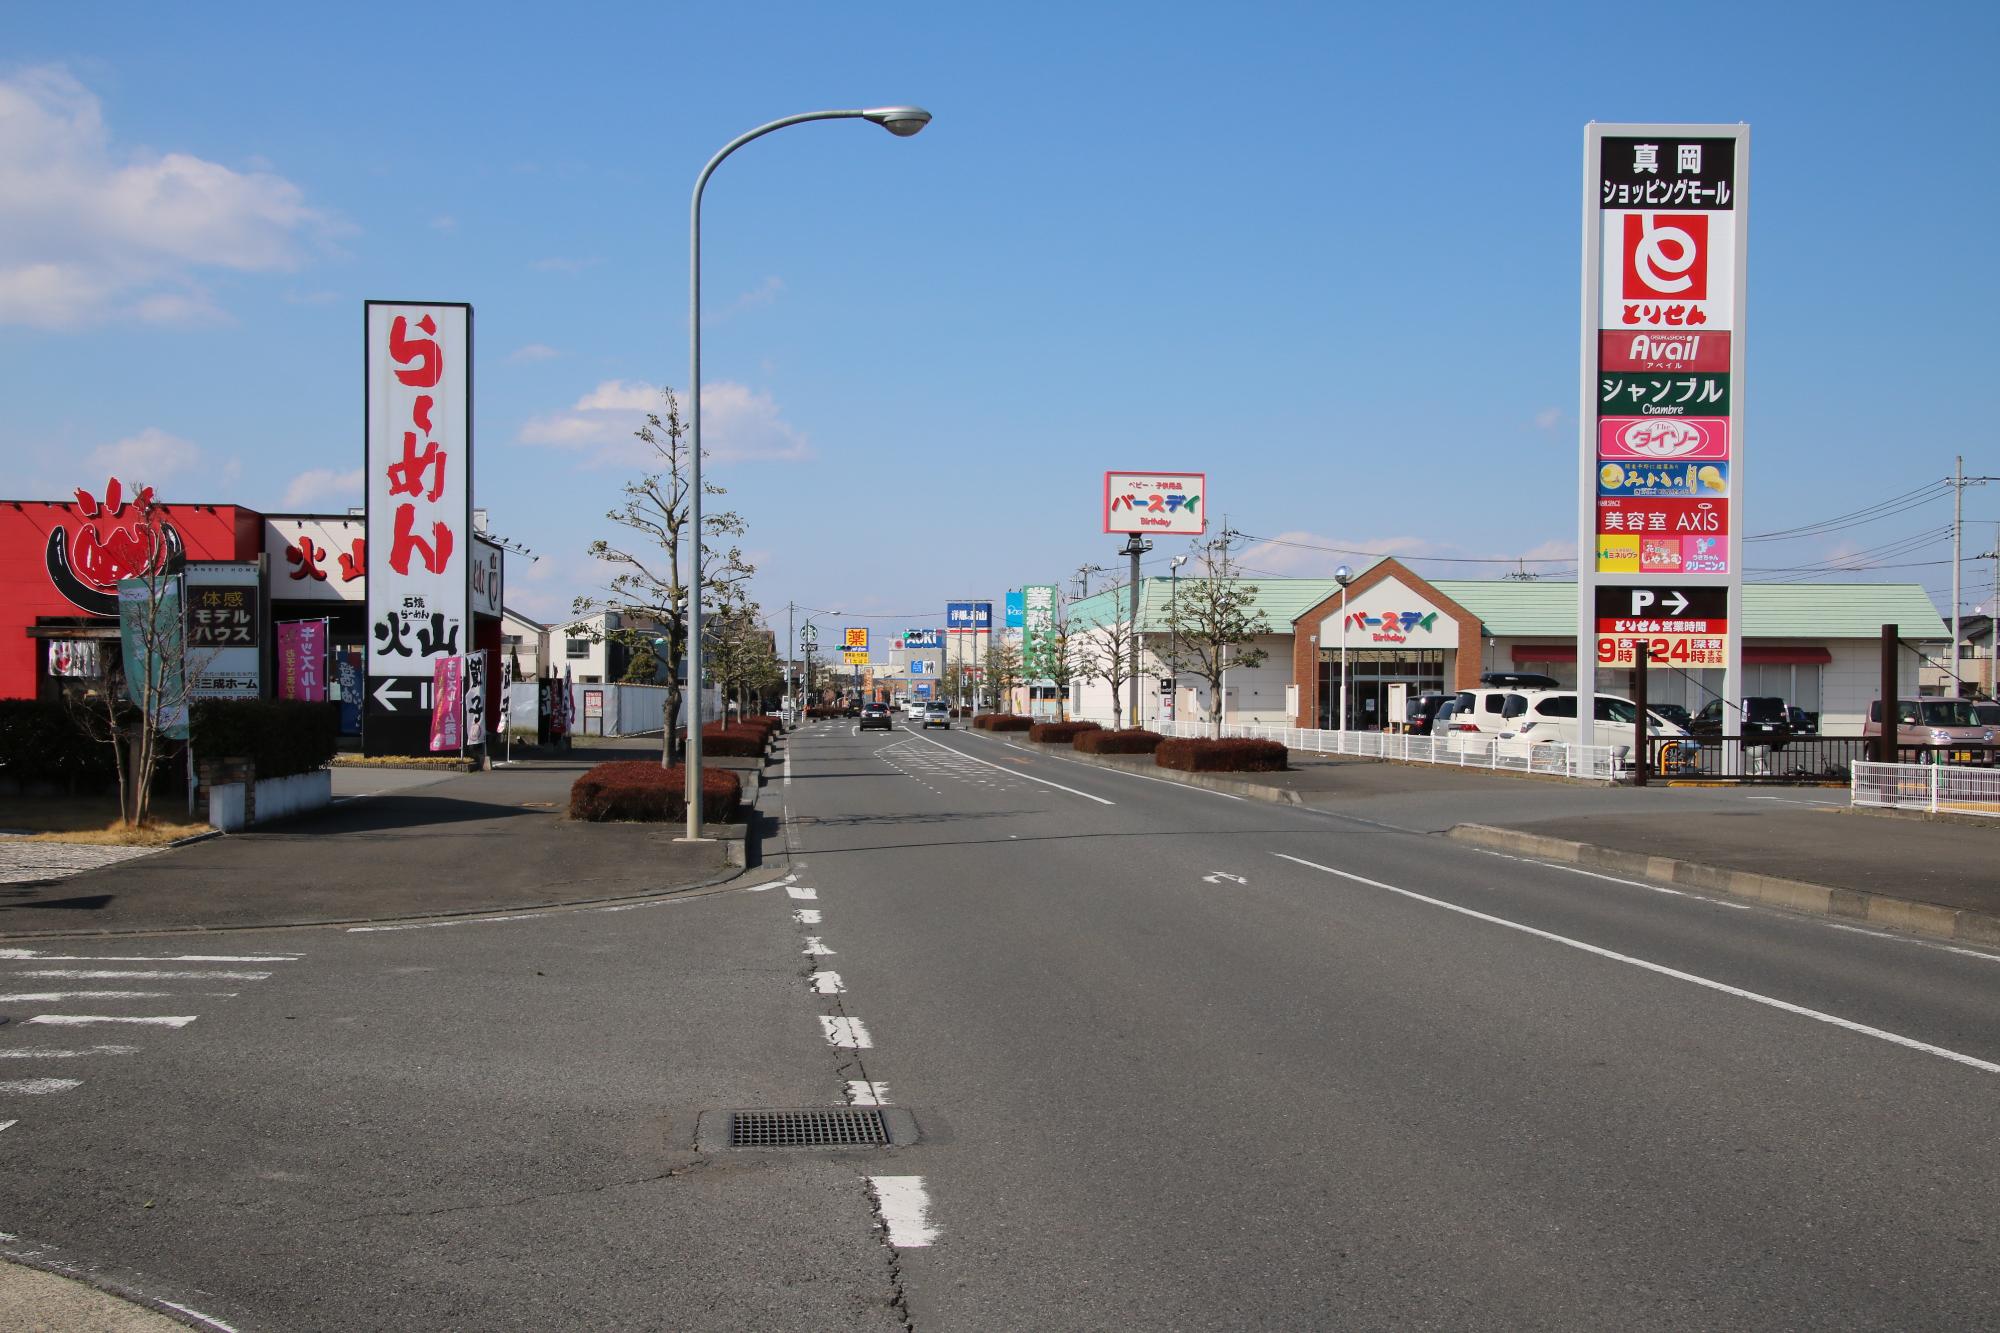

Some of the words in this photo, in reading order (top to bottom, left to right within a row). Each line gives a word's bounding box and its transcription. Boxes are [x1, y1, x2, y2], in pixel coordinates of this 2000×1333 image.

[1633, 144, 1702, 174] 真岡
[1603, 179, 1731, 205] ショッピングモール
[1622, 304, 1707, 326] とりせん
[1628, 334, 1700, 361] Avail
[1603, 377, 1724, 403] シャンブル
[1642, 403, 1684, 415] Chambre
[386, 313, 454, 576] らーめん
[1632, 429, 1698, 448] ダイソー
[1111, 494, 1200, 514] バースデイ
[1140, 517, 1172, 527] Birthday
[1604, 511, 1667, 531] 美容室
[1676, 508, 1719, 531] AXIS
[1685, 561, 1726, 571] クリーニング
[202, 591, 243, 607] 体感
[1631, 589, 1655, 616] P
[194, 626, 251, 641] ハウス
[374, 611, 459, 658] 火山
[1614, 620, 1661, 632] とりせん
[1662, 621, 1707, 632] 営業時間
[848, 629, 865, 646] 薬
[1372, 633, 1406, 644] Birthday
[1692, 639, 1722, 649] 深夜
